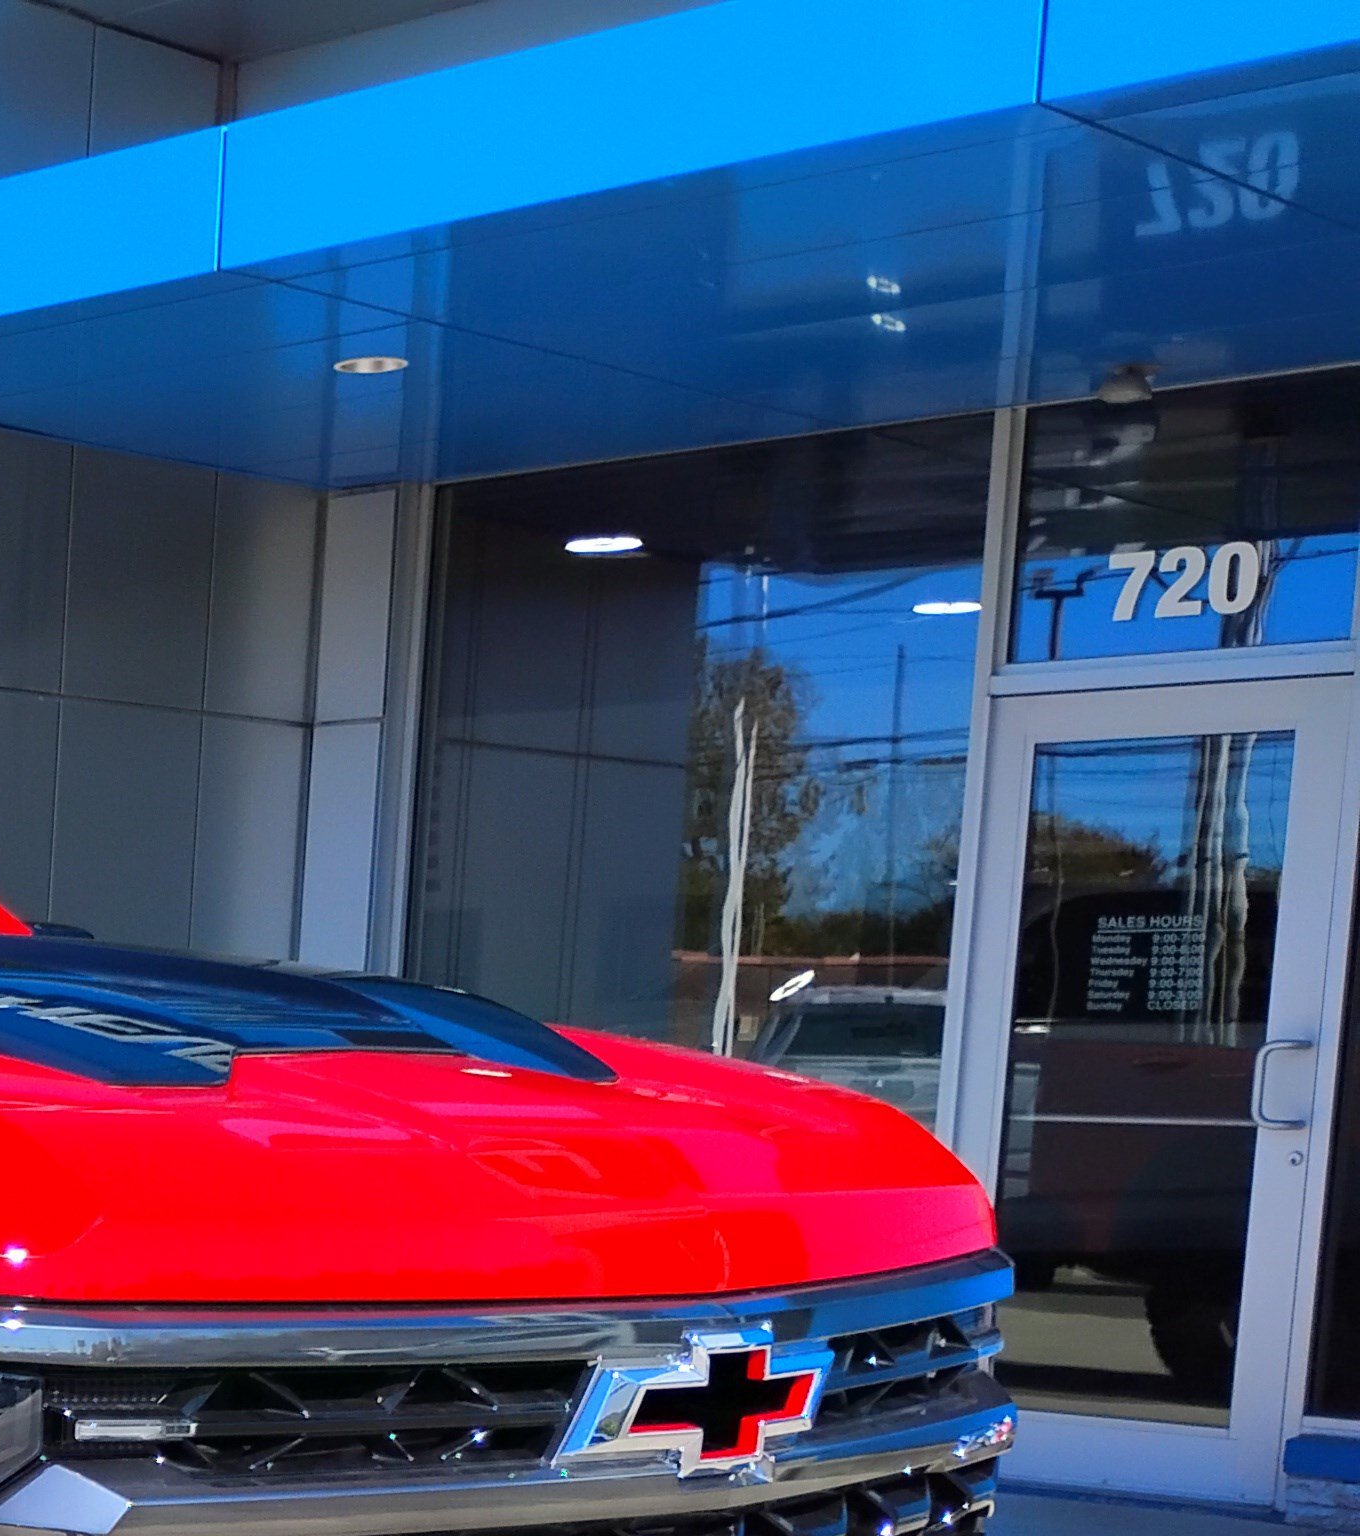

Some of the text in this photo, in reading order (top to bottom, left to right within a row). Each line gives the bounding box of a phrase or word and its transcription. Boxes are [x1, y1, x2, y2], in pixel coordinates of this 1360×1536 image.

[1109, 541, 1260, 622] 720
[1097, 914, 1204, 929] SALES HOURS
[1146, 1001, 1198, 1011] CLOSED
